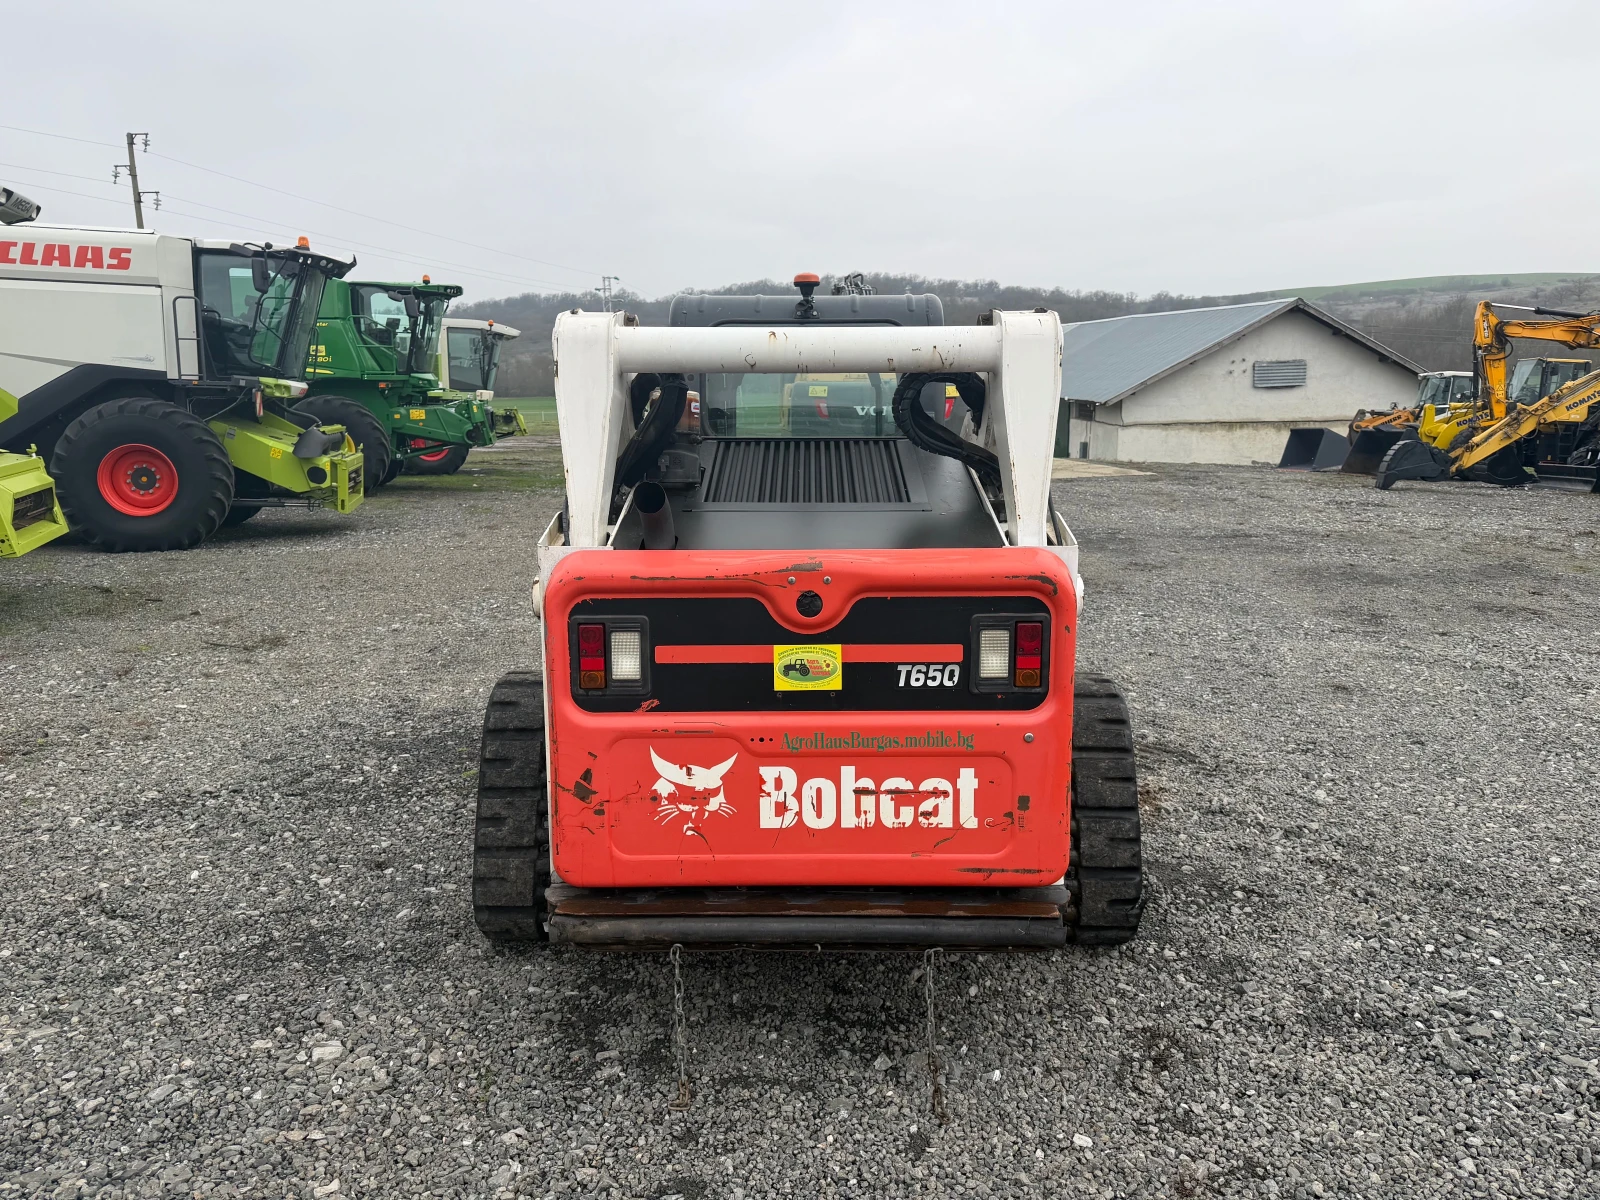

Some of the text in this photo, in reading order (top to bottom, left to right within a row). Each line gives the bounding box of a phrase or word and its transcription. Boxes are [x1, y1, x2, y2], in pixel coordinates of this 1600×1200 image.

[10, 197, 33, 214] MEGA
[0, 241, 132, 270] CLAAS
[1565, 390, 1600, 412] KOMATS
[1456, 411, 1490, 427] KOMATS
[896, 664, 960, 687] T650
[780, 731, 975, 753] AgroHausBurgas.mobile.bg
[759, 765, 979, 829] Bobcat
